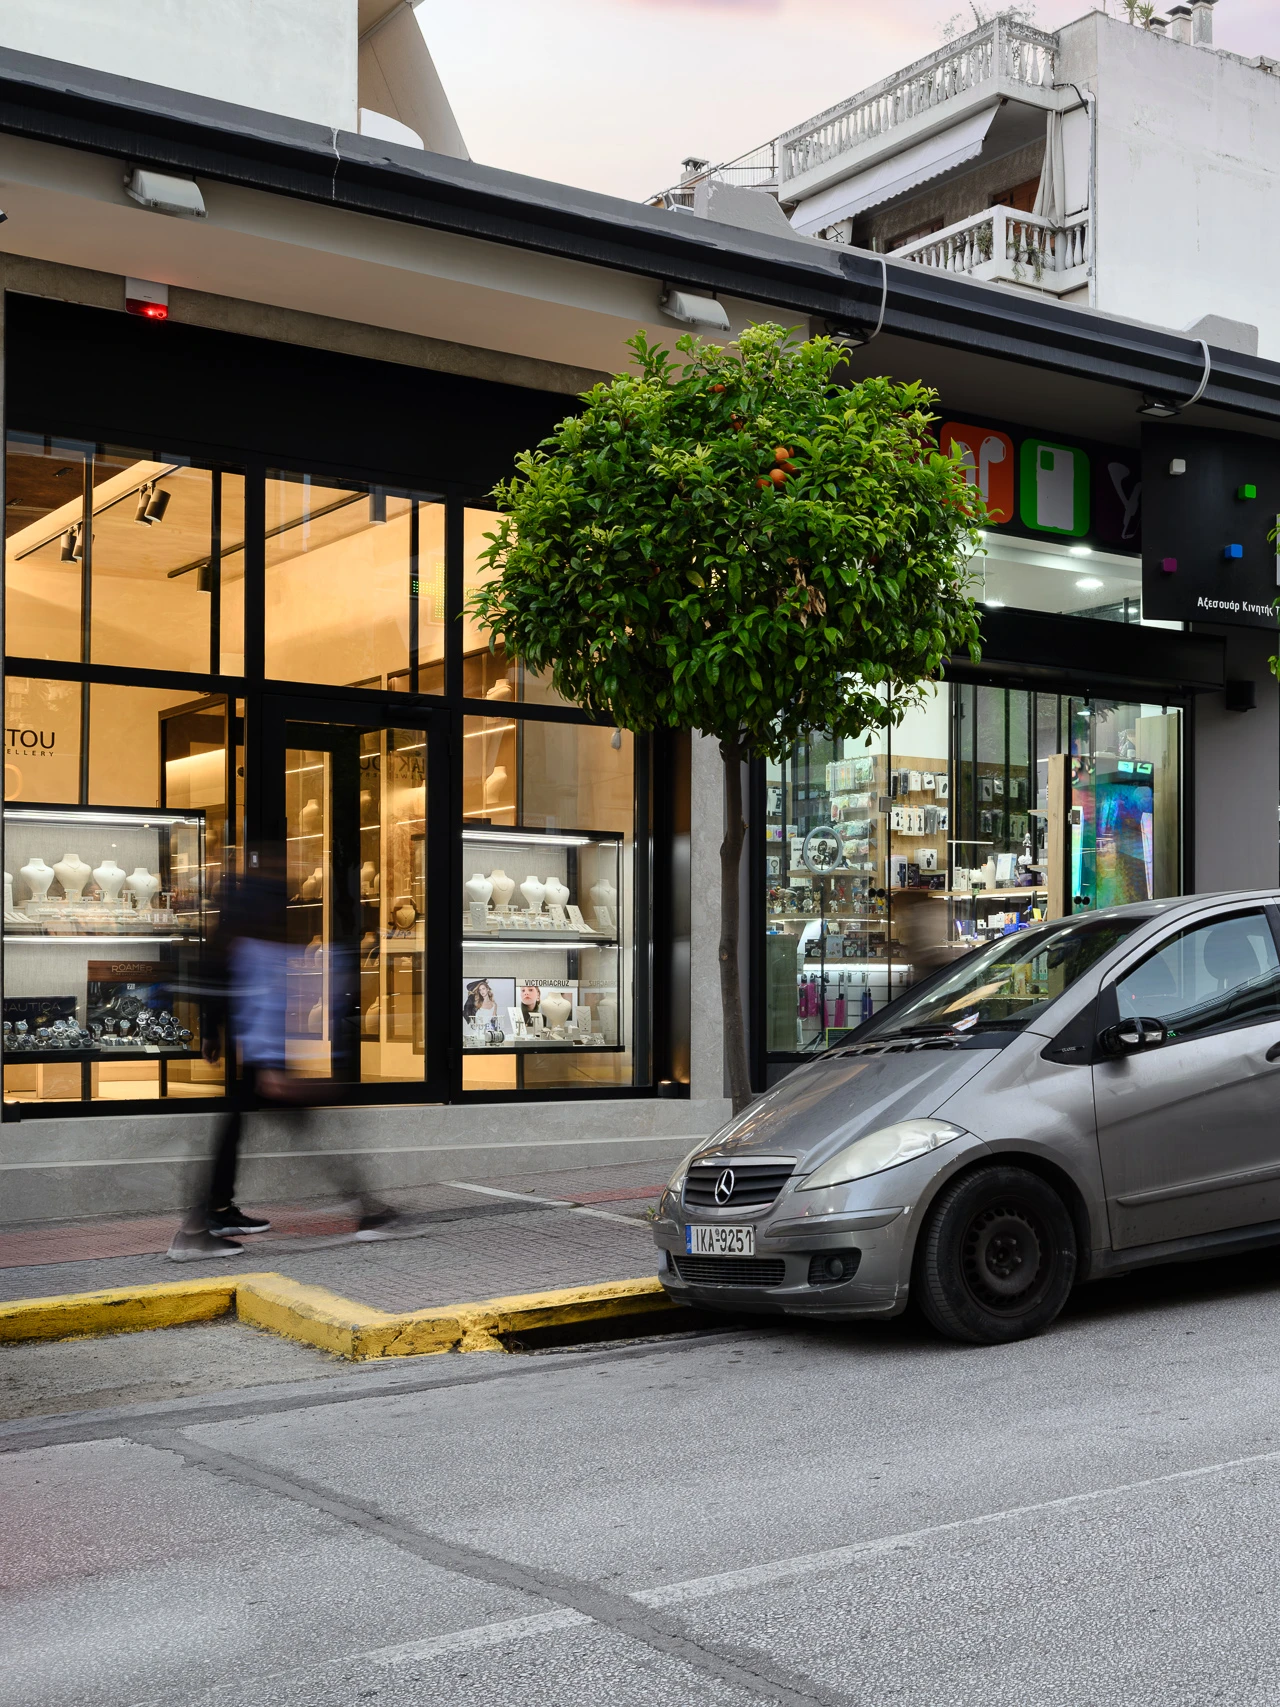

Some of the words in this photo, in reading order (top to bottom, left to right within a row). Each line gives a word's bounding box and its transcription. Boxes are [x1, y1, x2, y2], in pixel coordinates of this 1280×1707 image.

[1197, 597, 1240, 612] Αξεσουάρ
[6, 729, 55, 749] TOU
[111, 963, 152, 974] ROAMER
[524, 979, 570, 987] VICTORIACRUZ
